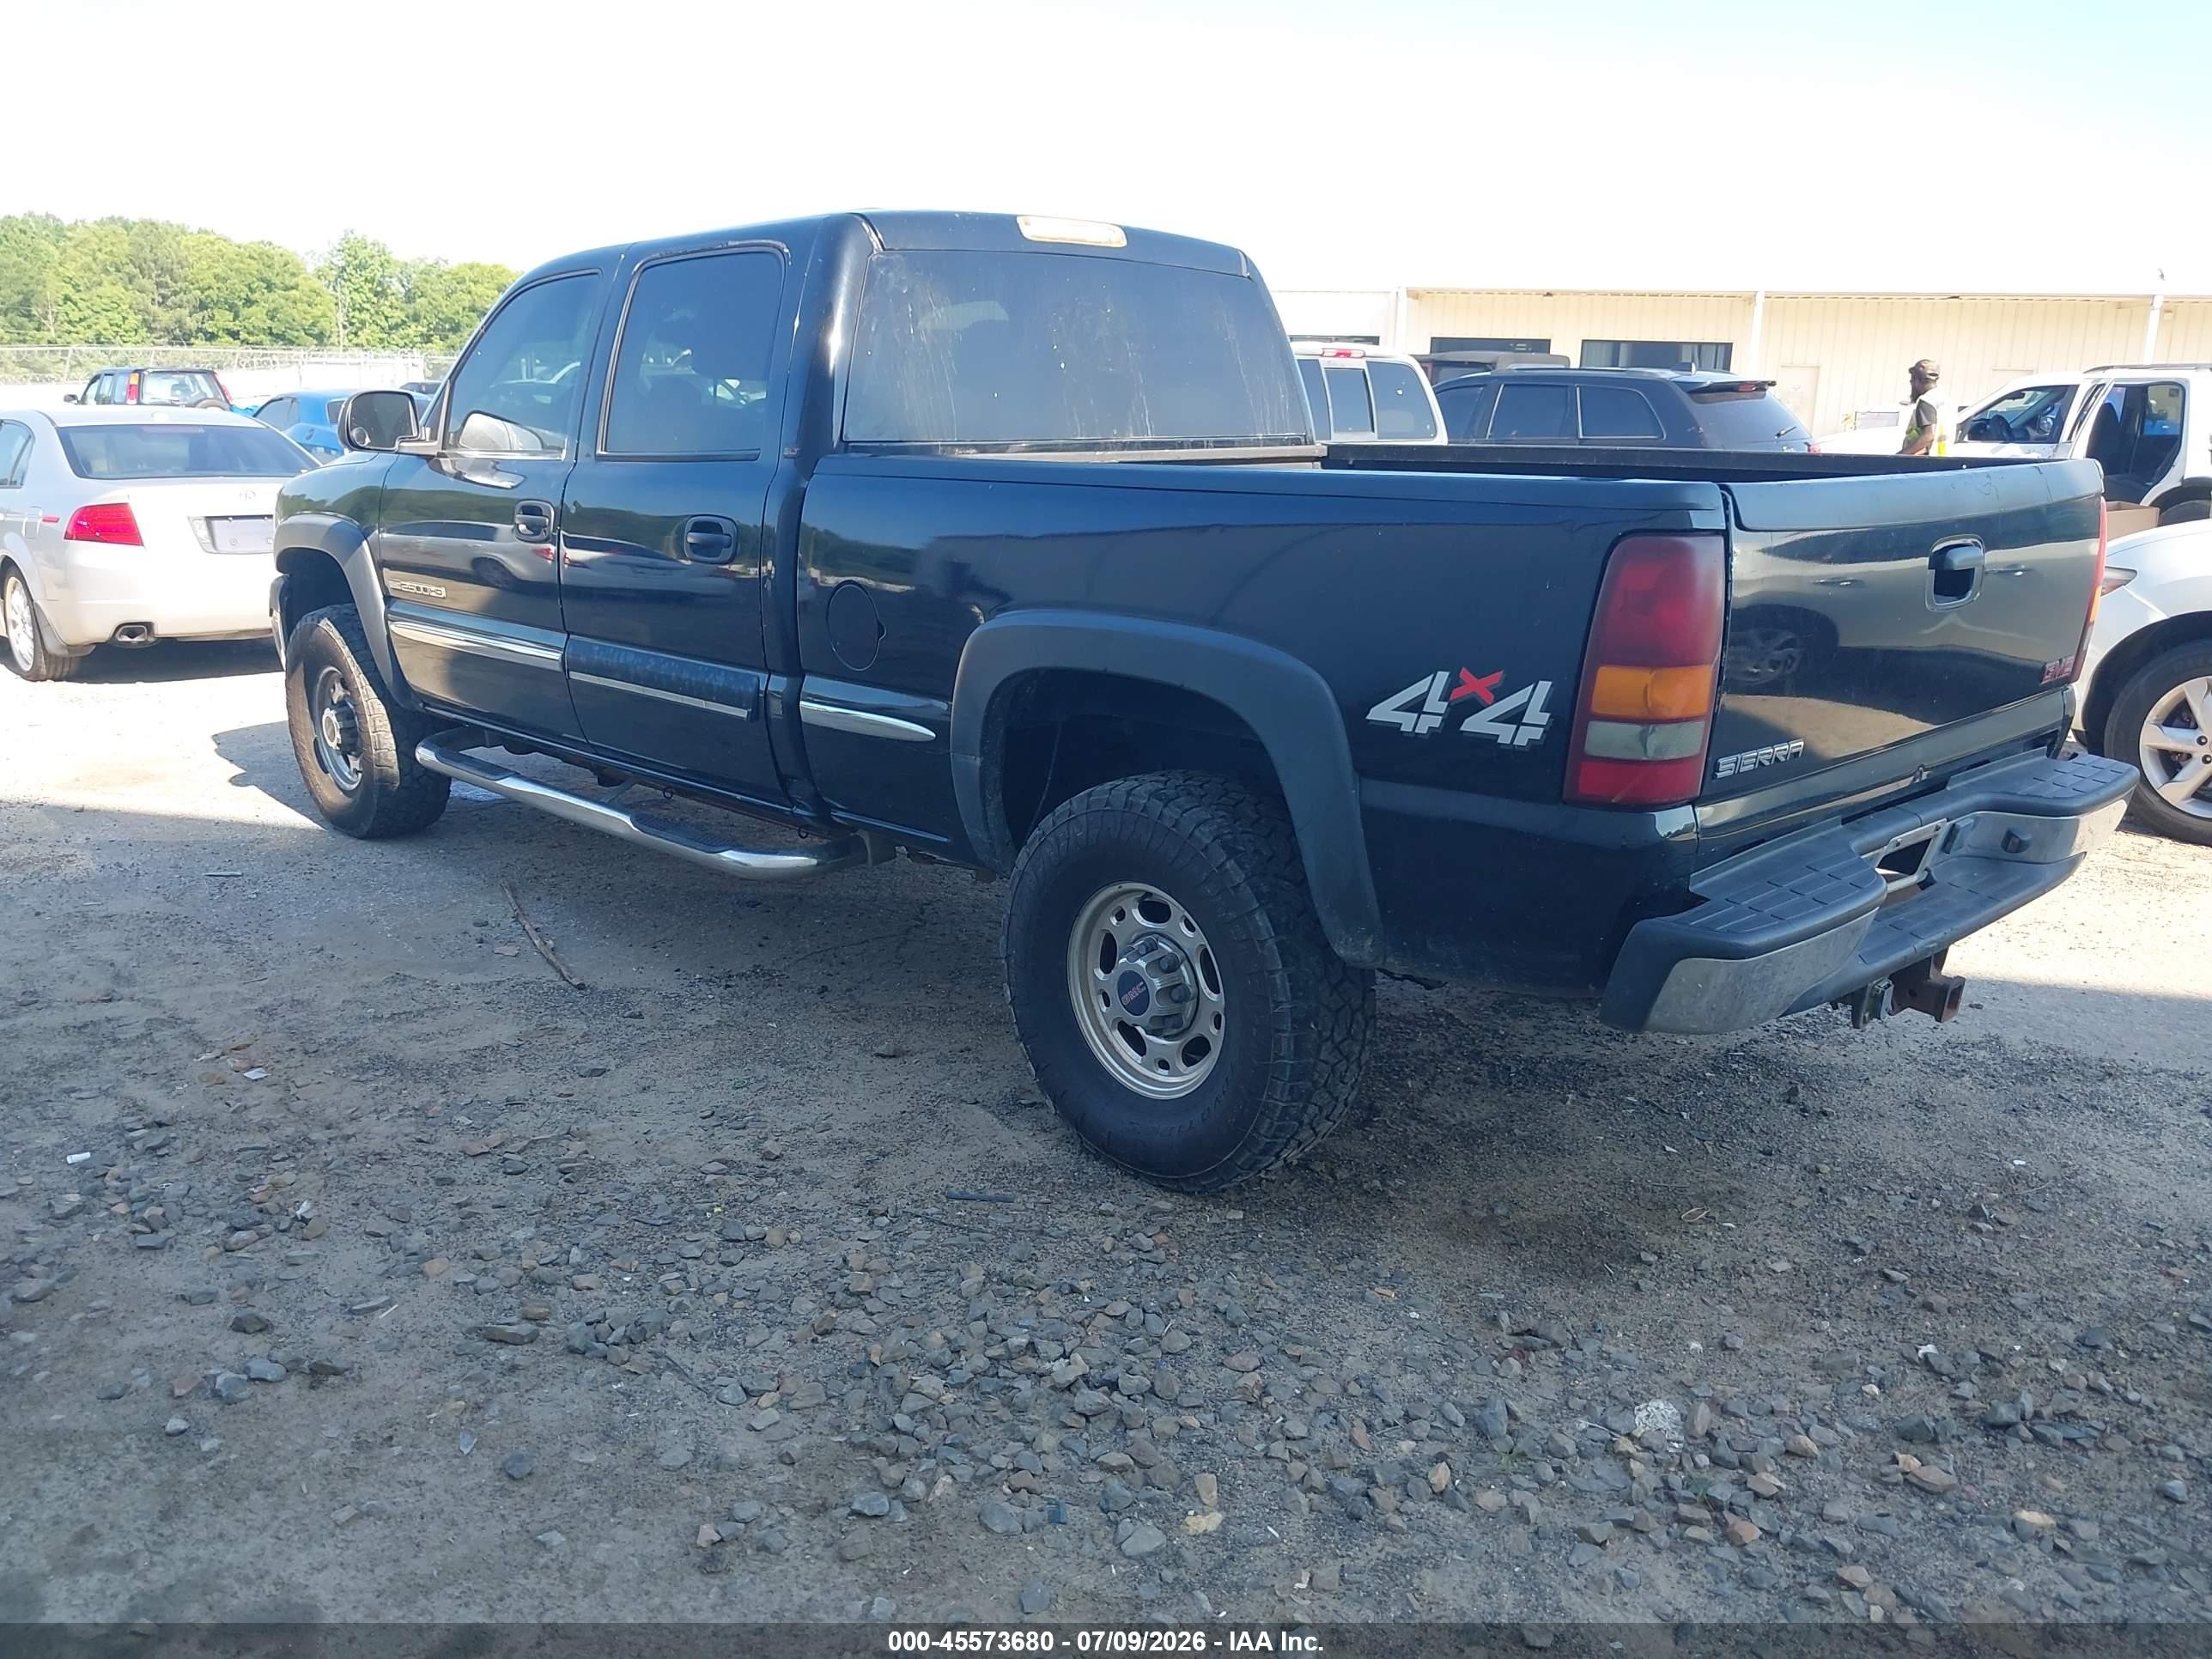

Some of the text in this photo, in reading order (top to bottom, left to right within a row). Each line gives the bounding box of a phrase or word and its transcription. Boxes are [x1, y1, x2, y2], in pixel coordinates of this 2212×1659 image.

[2041, 655, 2075, 684] GMC
[1713, 738, 1805, 779] SIERRA
[1121, 981, 1146, 1006] GMC
